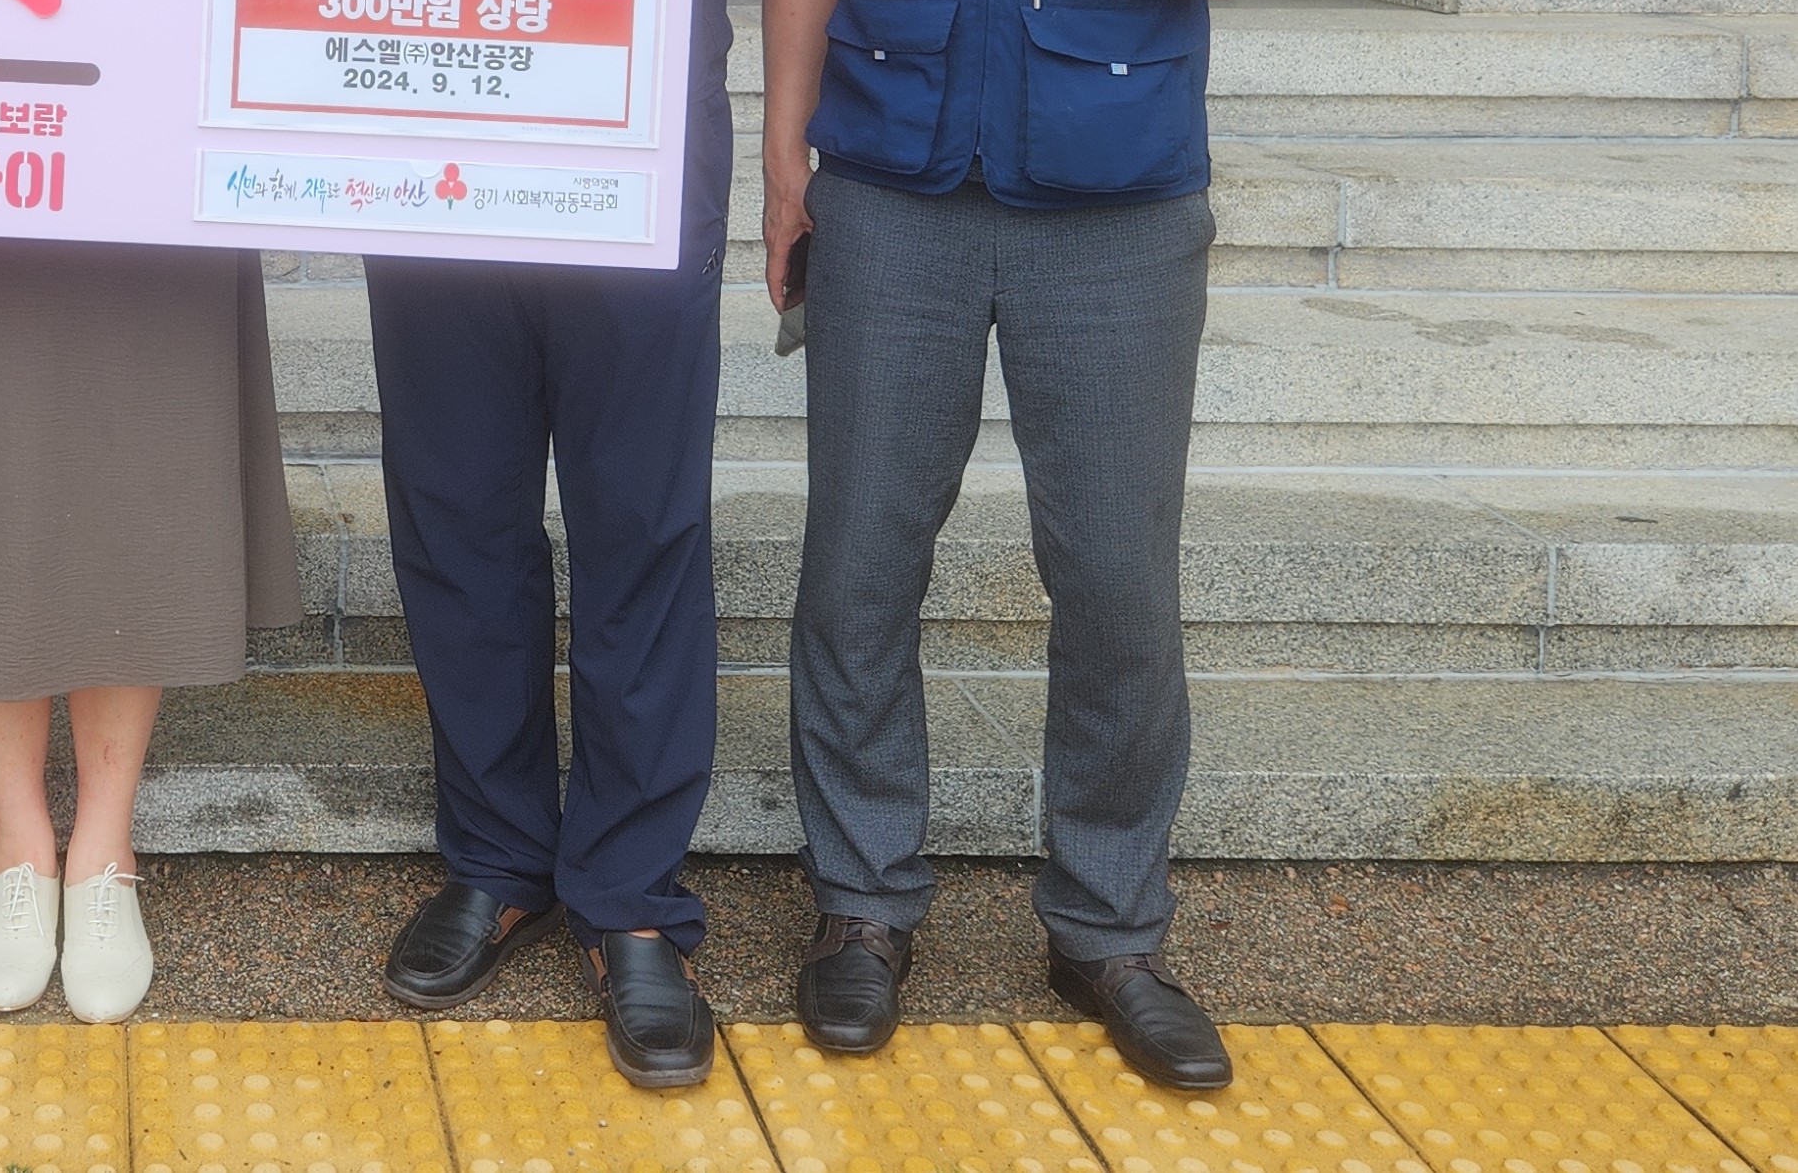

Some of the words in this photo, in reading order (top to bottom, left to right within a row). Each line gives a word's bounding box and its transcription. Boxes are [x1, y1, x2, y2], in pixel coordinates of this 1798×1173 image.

[343, 68, 418, 94] 2024.
[432, 72, 456, 96] 9.
[471, 74, 510, 99] 12.
[227, 164, 268, 208] 시민과
[301, 178, 341, 213] 자유로운
[345, 178, 390, 213] 혁신도시
[394, 178, 429, 207] 안산
[473, 188, 498, 210] 경기
[503, 189, 618, 214] 사회복지공동모금회
